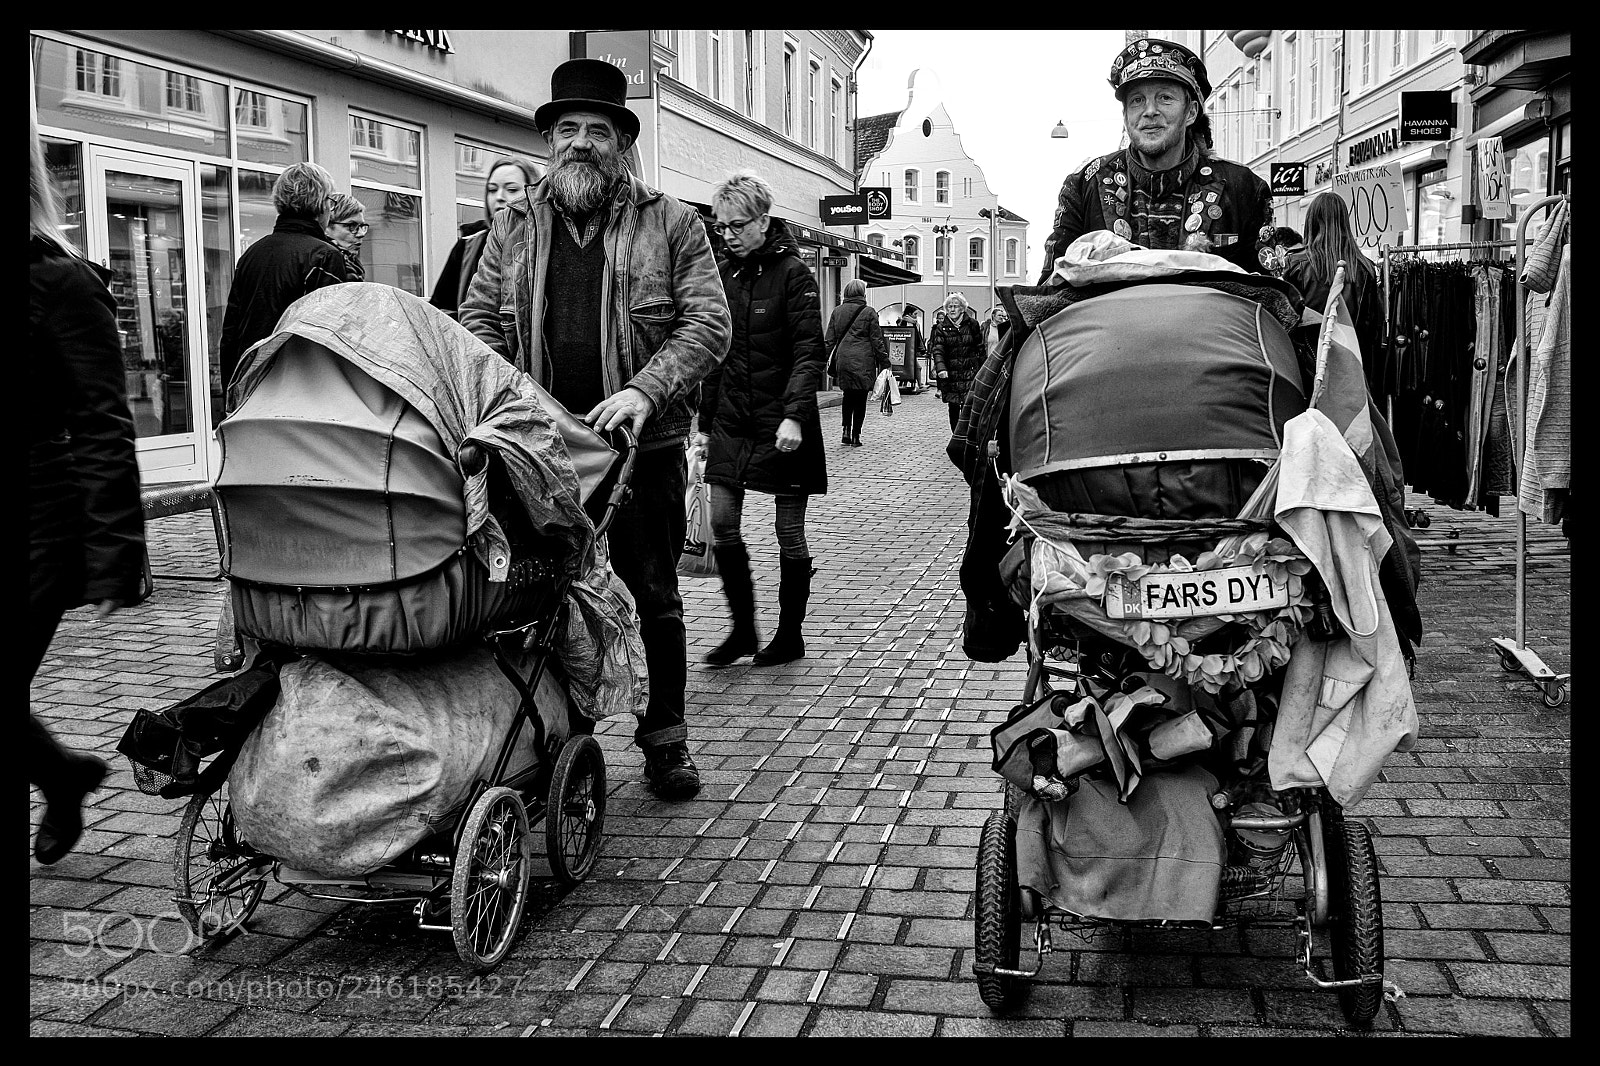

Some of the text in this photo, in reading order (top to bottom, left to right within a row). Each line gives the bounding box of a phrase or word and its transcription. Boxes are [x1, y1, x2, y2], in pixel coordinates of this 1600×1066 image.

[1404, 119, 1449, 127] HAVANNA
[1410, 127, 1442, 135] SHOES
[1349, 128, 1398, 166] HAVANNA
[1146, 580, 1219, 609] FARS
[1125, 604, 1141, 613] DK
